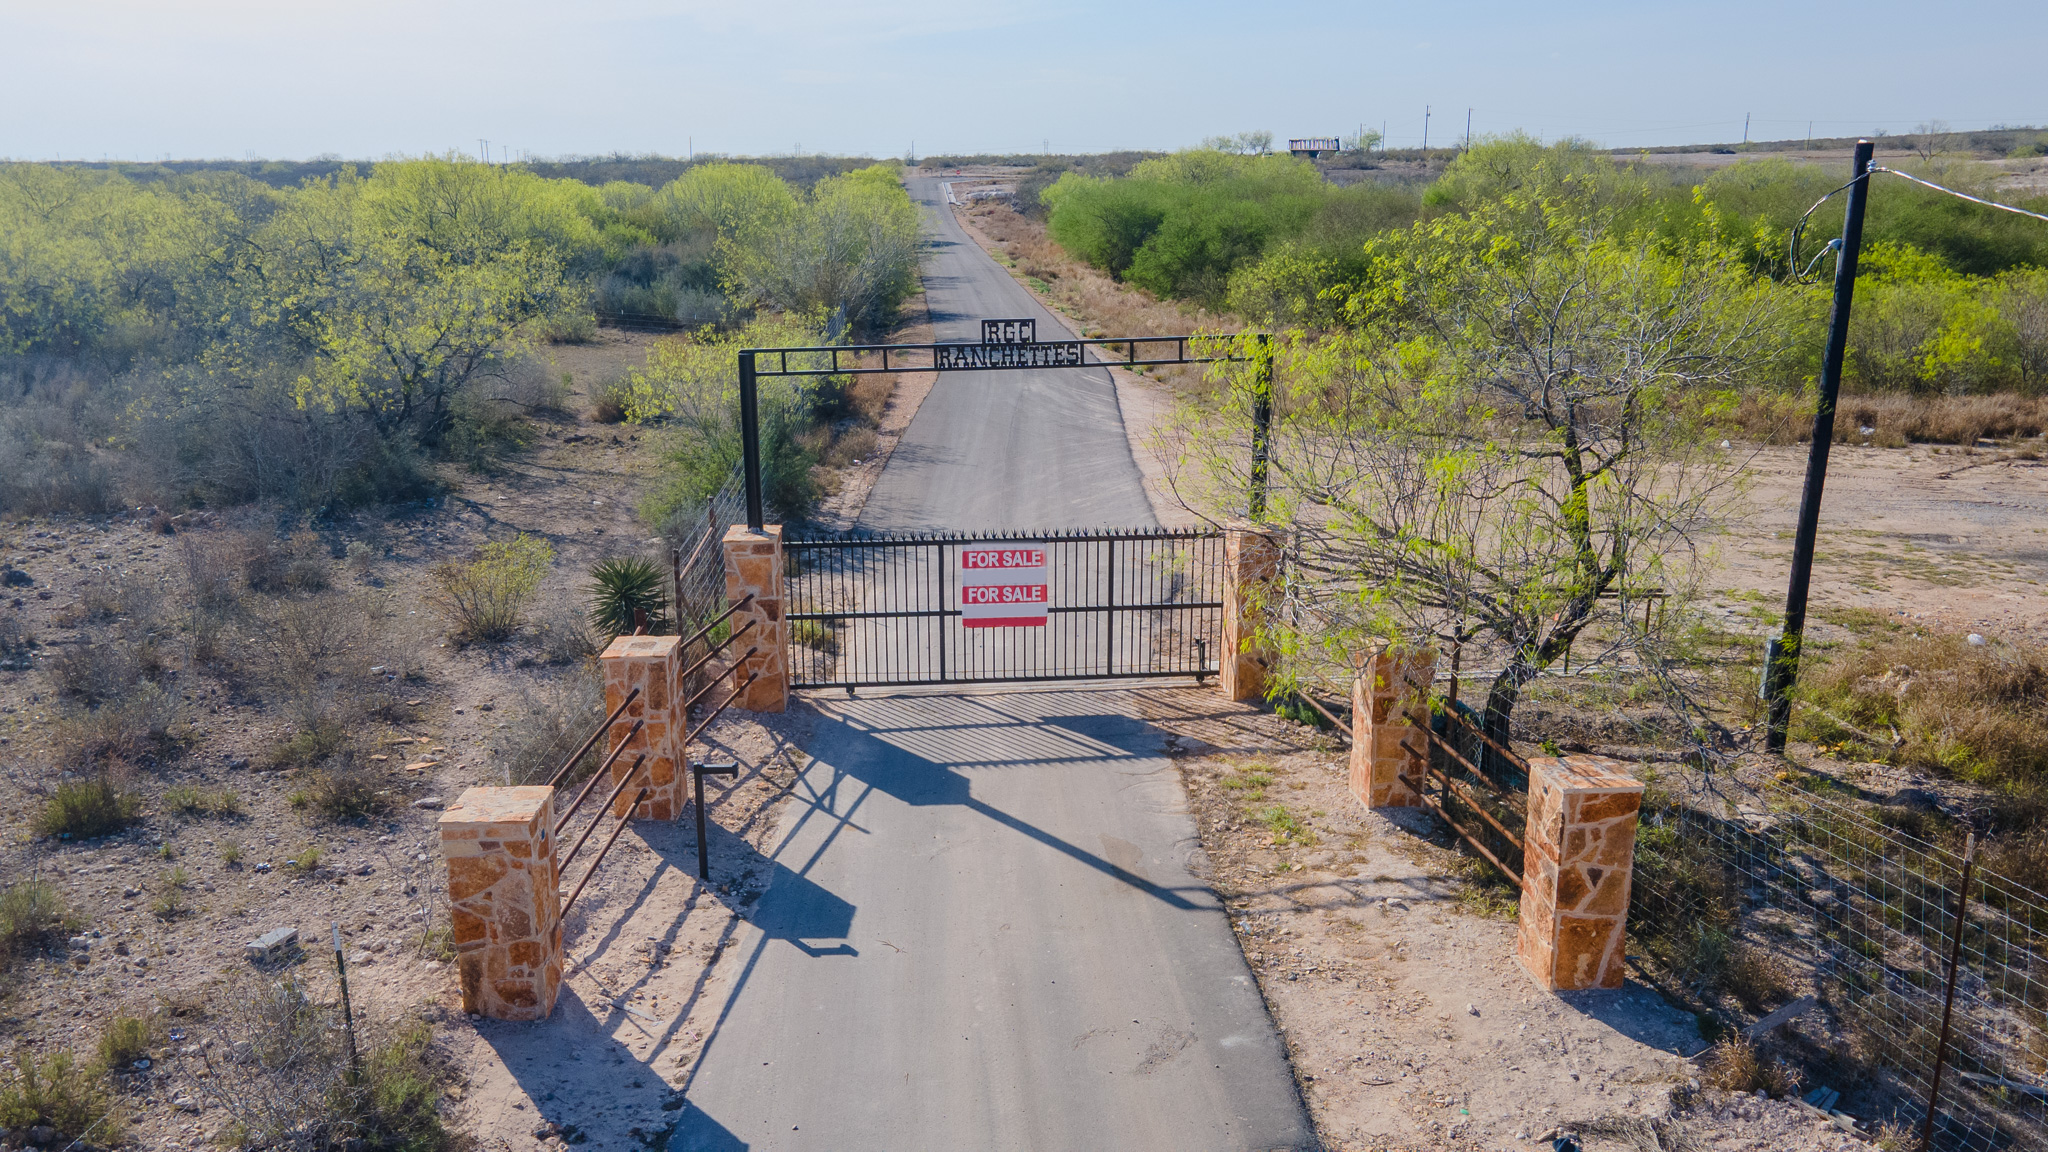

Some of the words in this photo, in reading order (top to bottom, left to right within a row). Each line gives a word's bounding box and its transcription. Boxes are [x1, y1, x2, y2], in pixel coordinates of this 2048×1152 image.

[987, 321, 1030, 343] RGC
[938, 343, 1080, 368] RANCHETTES
[968, 552, 999, 567] FOR
[1002, 551, 1041, 567] SALE
[968, 587, 999, 603] FOR
[1002, 586, 1041, 602] SALE
